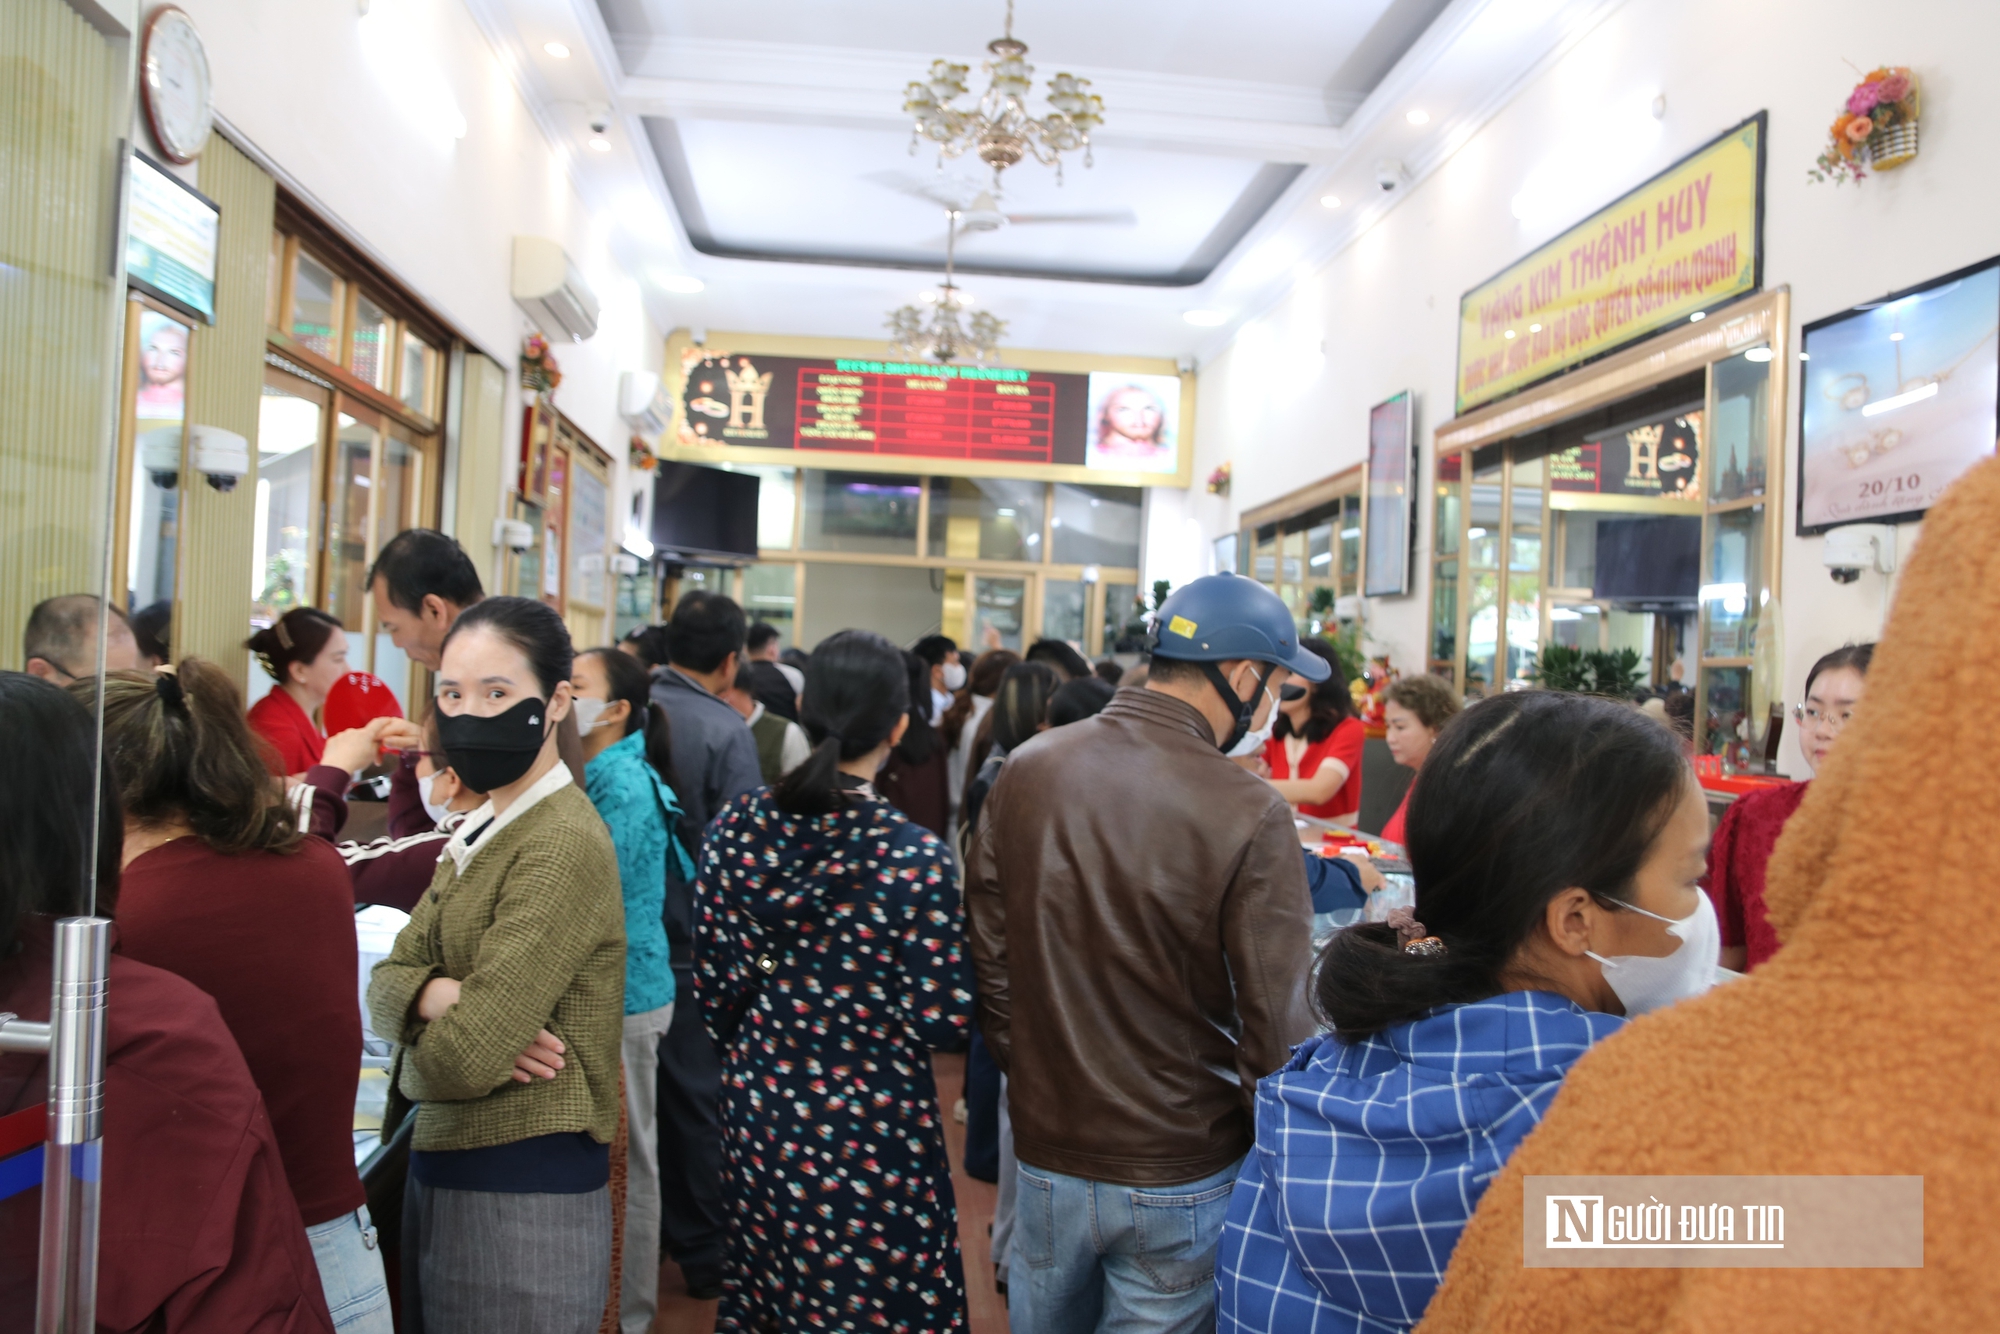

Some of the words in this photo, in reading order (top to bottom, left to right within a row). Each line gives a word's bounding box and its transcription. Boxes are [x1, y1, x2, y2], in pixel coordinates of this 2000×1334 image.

[1480, 283, 1523, 339] VÀNG
[1529, 258, 1562, 314] KIM
[1569, 209, 1646, 290] THÀNH
[1657, 172, 1713, 249] HUY
[1859, 473, 1921, 498] 20/10
